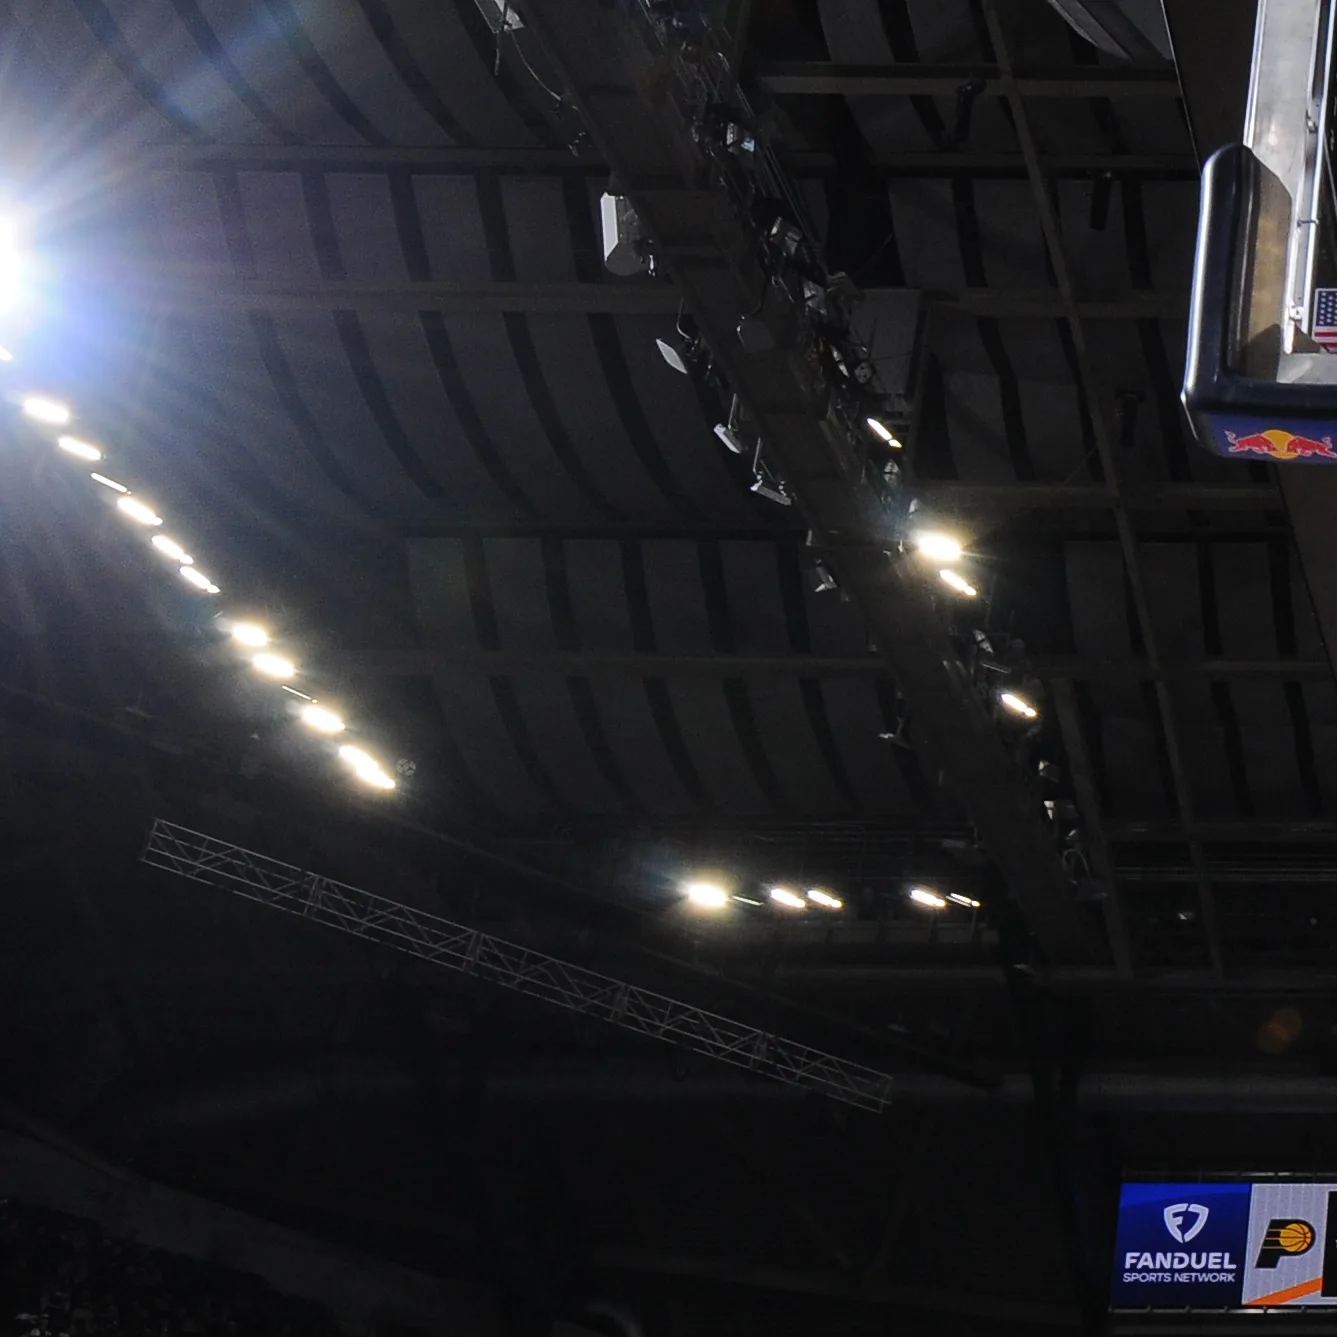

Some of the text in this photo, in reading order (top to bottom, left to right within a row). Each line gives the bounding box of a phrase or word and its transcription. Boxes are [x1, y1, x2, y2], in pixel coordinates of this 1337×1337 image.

[1124, 1252, 1237, 1269] FANDUEL
[1122, 1272, 1235, 1283] SPORTS NETWORK
